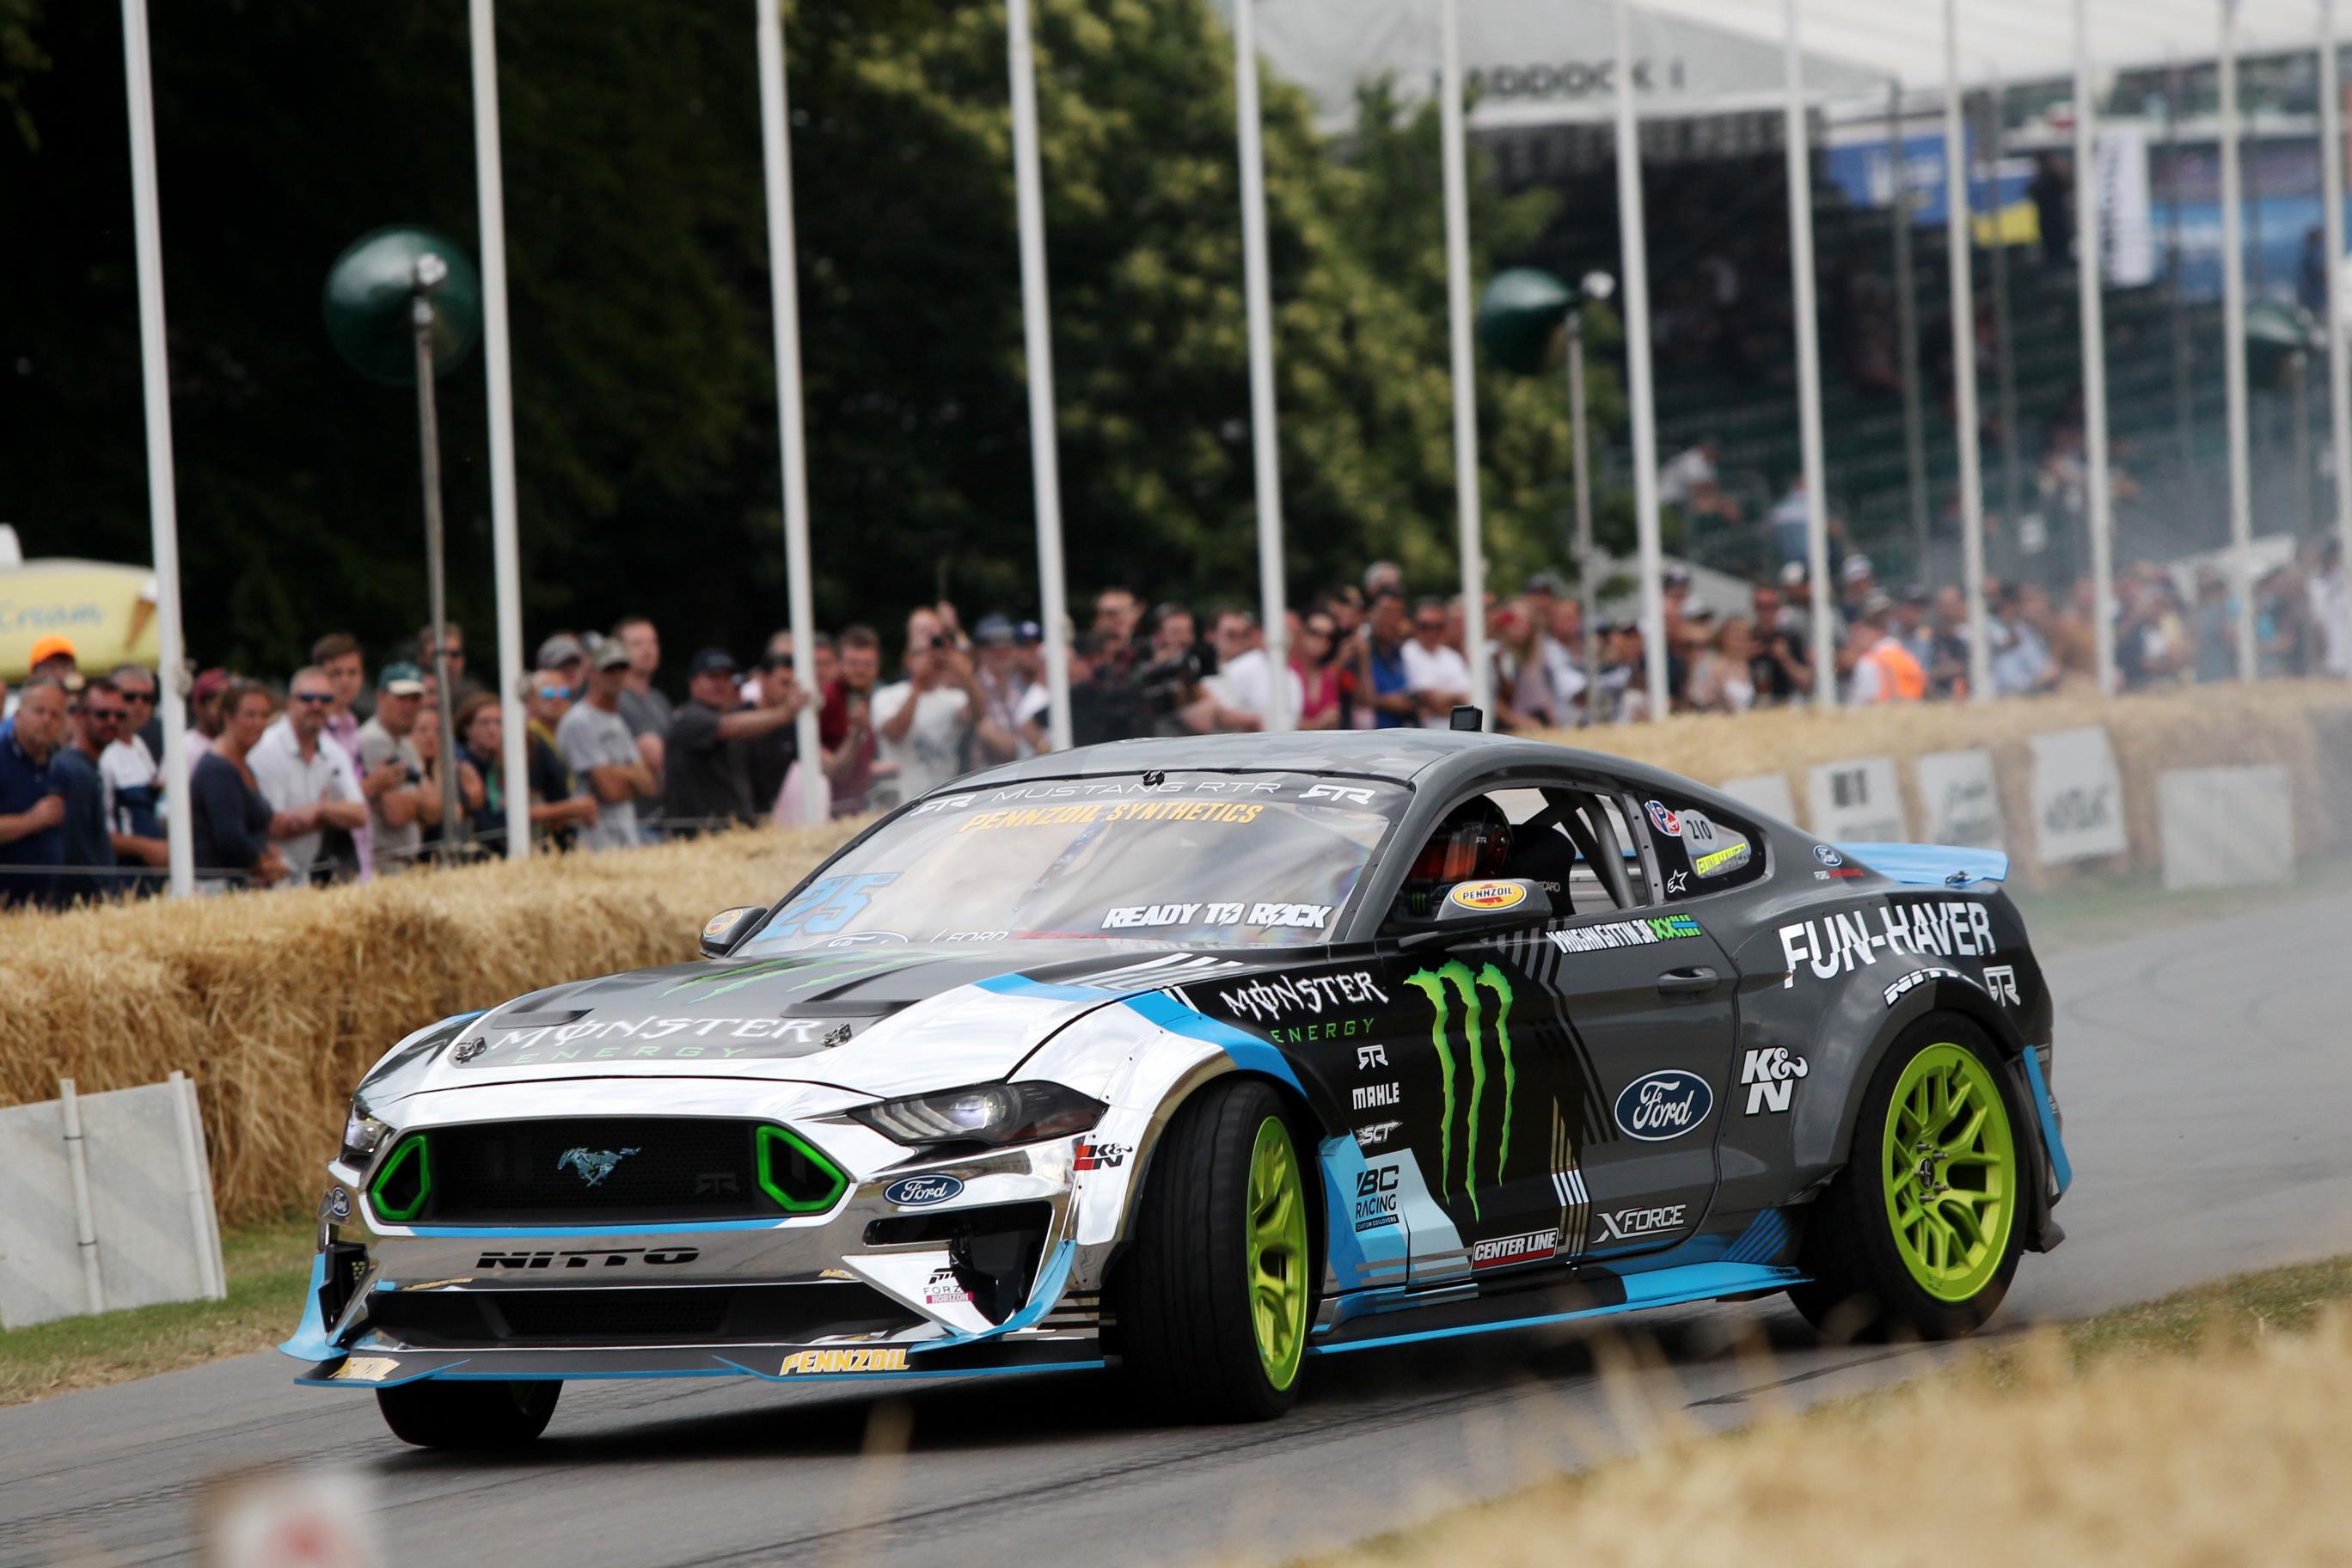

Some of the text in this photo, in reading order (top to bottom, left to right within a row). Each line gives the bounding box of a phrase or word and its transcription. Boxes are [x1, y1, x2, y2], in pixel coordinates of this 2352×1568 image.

[991, 781, 1282, 801] MUSTANG RTR
[959, 803, 1264, 832] PENNZOIL SYNTHETICS
[1686, 819, 1712, 840] 210
[1462, 886, 1513, 901] PENNZOIL
[756, 872, 904, 943] 25
[1101, 902, 1334, 932] READY TO ROCK
[1779, 902, 1997, 989] FUN-HAVER
[1271, 1018, 1374, 1044] ENERGY
[512, 1045, 748, 1064] ENERGY
[1352, 1081, 1400, 1110] MAHLE
[1632, 1080, 1694, 1130] Ford
[900, 1178, 947, 1202] Ford
[1355, 1193, 1397, 1220] RACING
[475, 1246, 700, 1270] NITTO
[1473, 1231, 1557, 1262] CENTER LINE
[923, 1284, 961, 1294] FORZ
[779, 1348, 911, 1376] PENNZOIL
